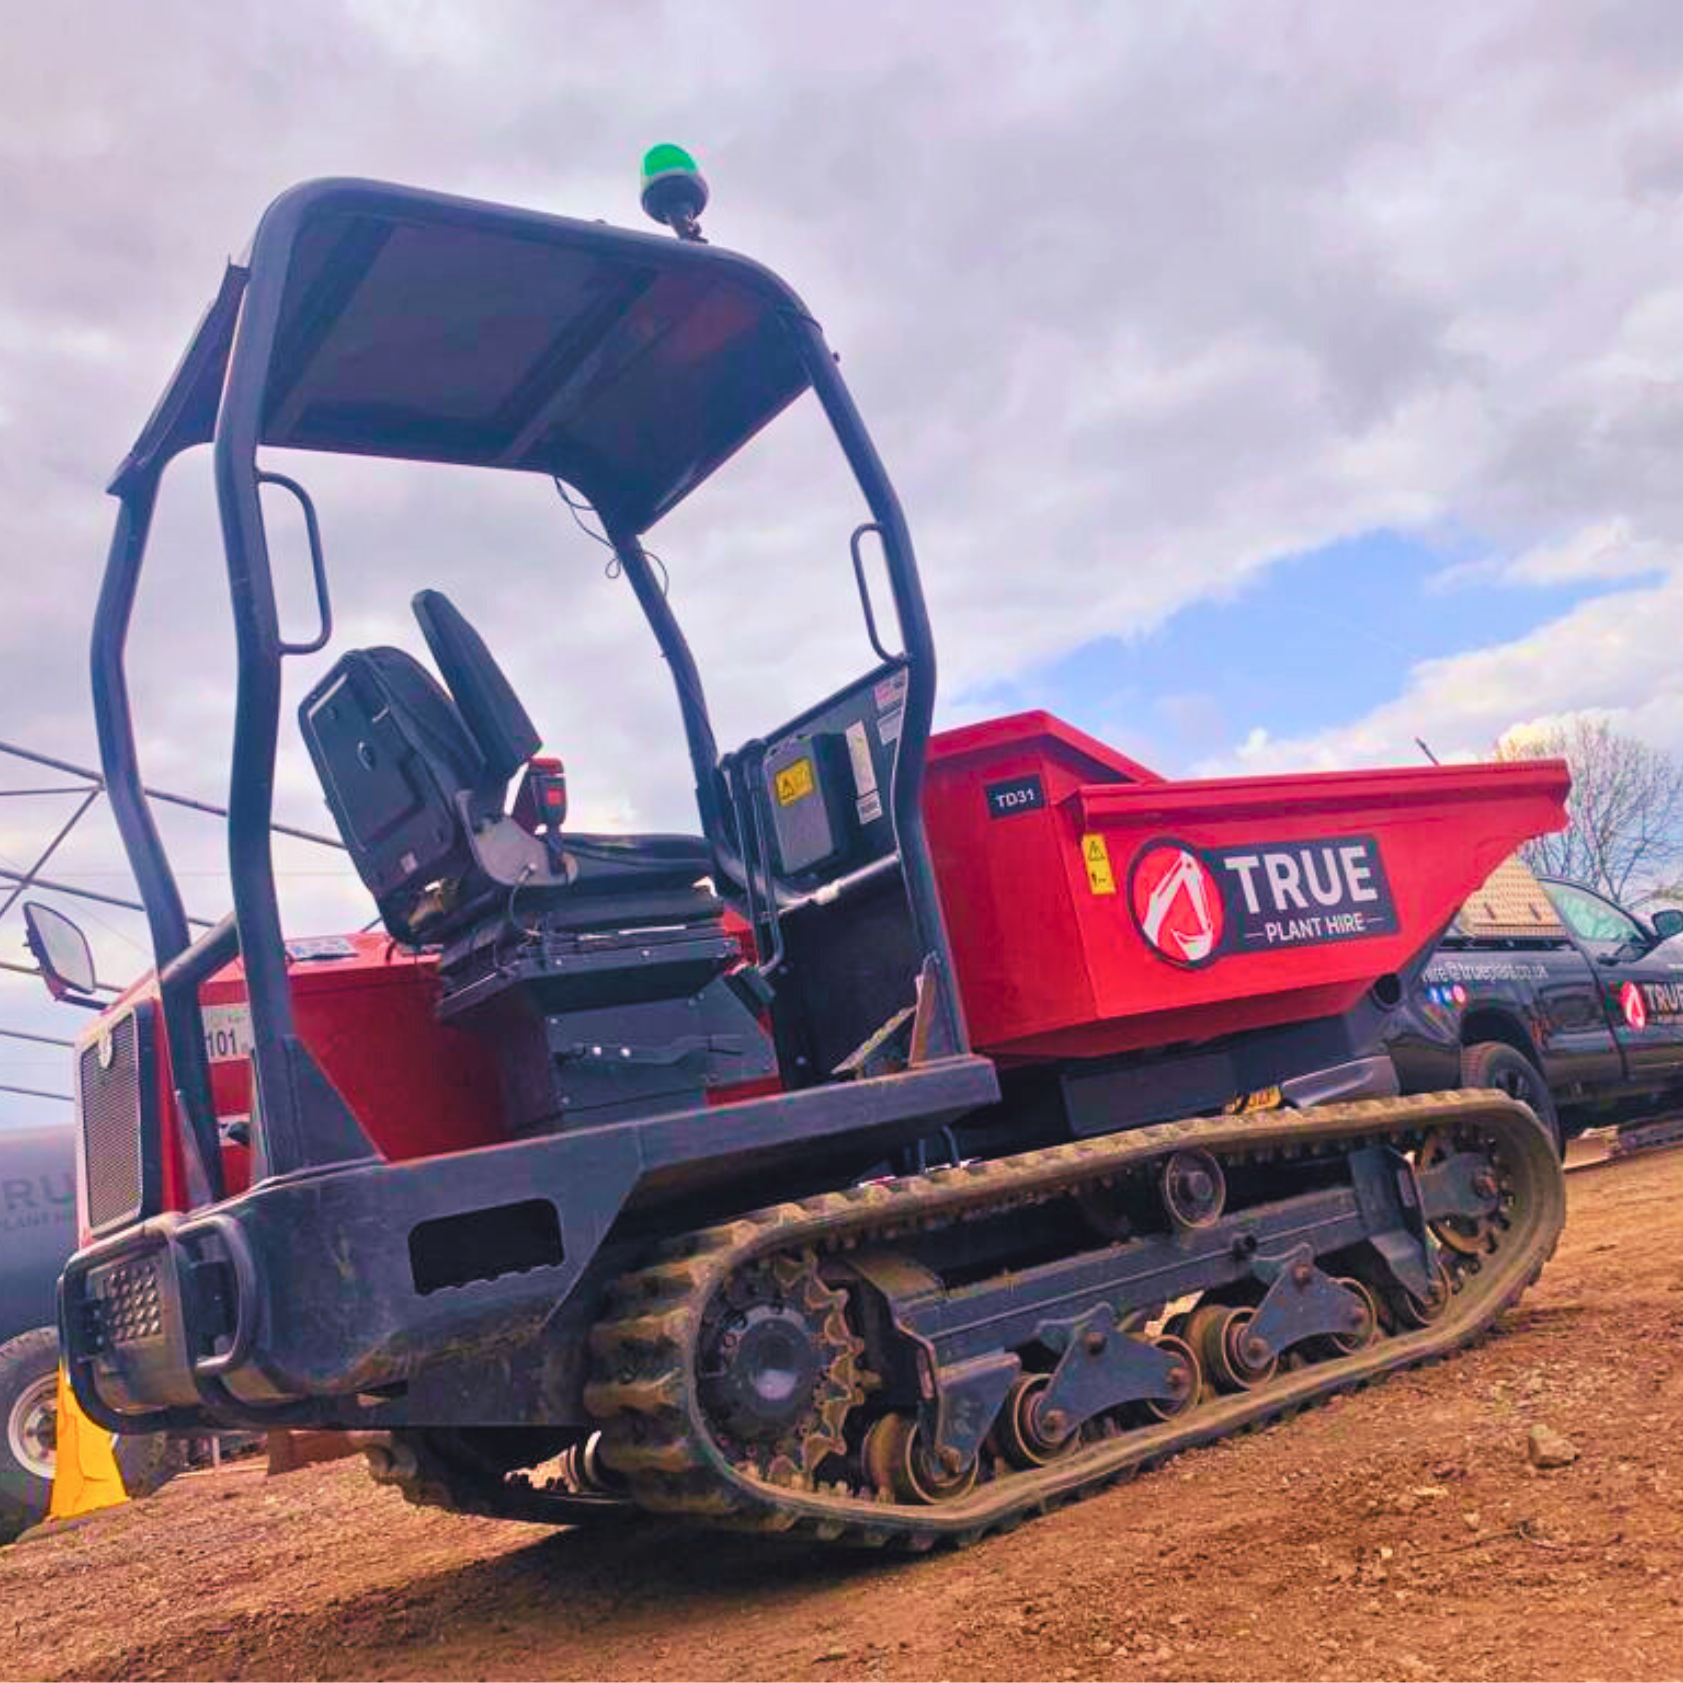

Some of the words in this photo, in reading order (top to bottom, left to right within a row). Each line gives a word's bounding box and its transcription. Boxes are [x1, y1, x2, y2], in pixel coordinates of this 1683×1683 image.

[996, 788, 1034, 807] TD31
[1223, 845, 1378, 914] TRUE
[1265, 917, 1323, 943] PLANT
[1325, 913, 1366, 935] HIRE
